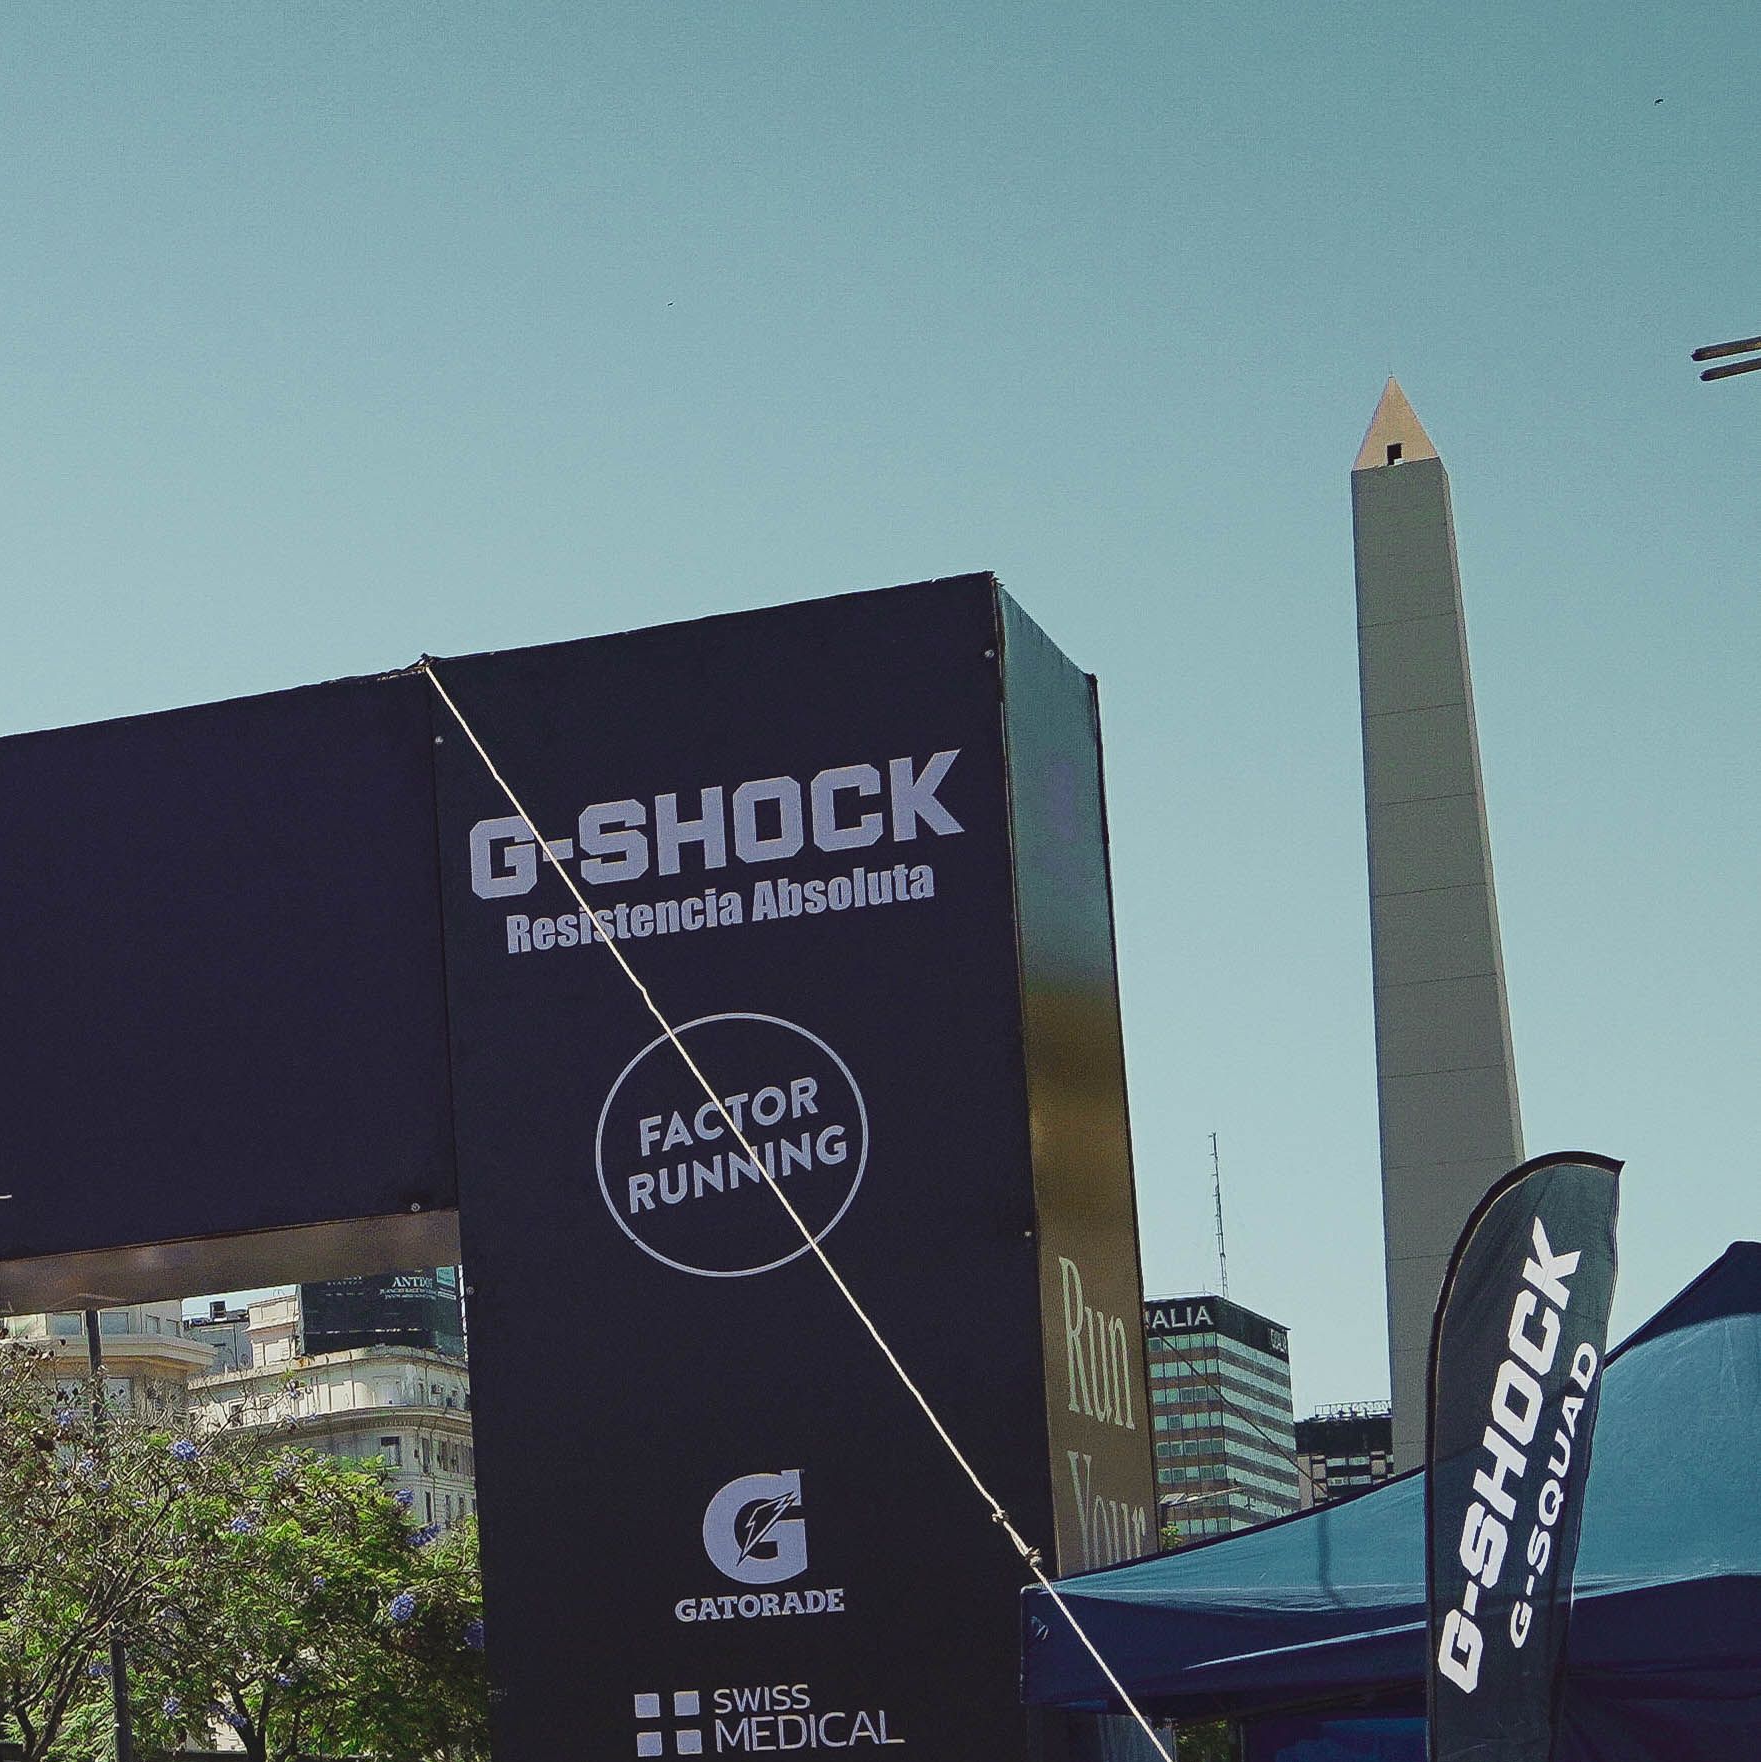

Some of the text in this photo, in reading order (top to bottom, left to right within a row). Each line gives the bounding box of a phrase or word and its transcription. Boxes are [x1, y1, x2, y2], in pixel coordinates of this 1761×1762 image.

[469, 747, 966, 901] G-SHOCK
[506, 859, 936, 955] Resistencia Absoluta
[637, 1075, 820, 1158] FACTOR
[628, 1122, 849, 1215] RUNNING
[1058, 1255, 1136, 1431] Run
[1145, 1305, 1214, 1330] ALIA
[1436, 1216, 1583, 1695] G-SHOCK
[1508, 1341, 1599, 1649] G-SQUAD
[1066, 1449, 1147, 1572] Your
[674, 1588, 845, 1622] GATORADE
[713, 1683, 811, 1714] SWISS
[715, 1709, 906, 1754] MEDICAL
